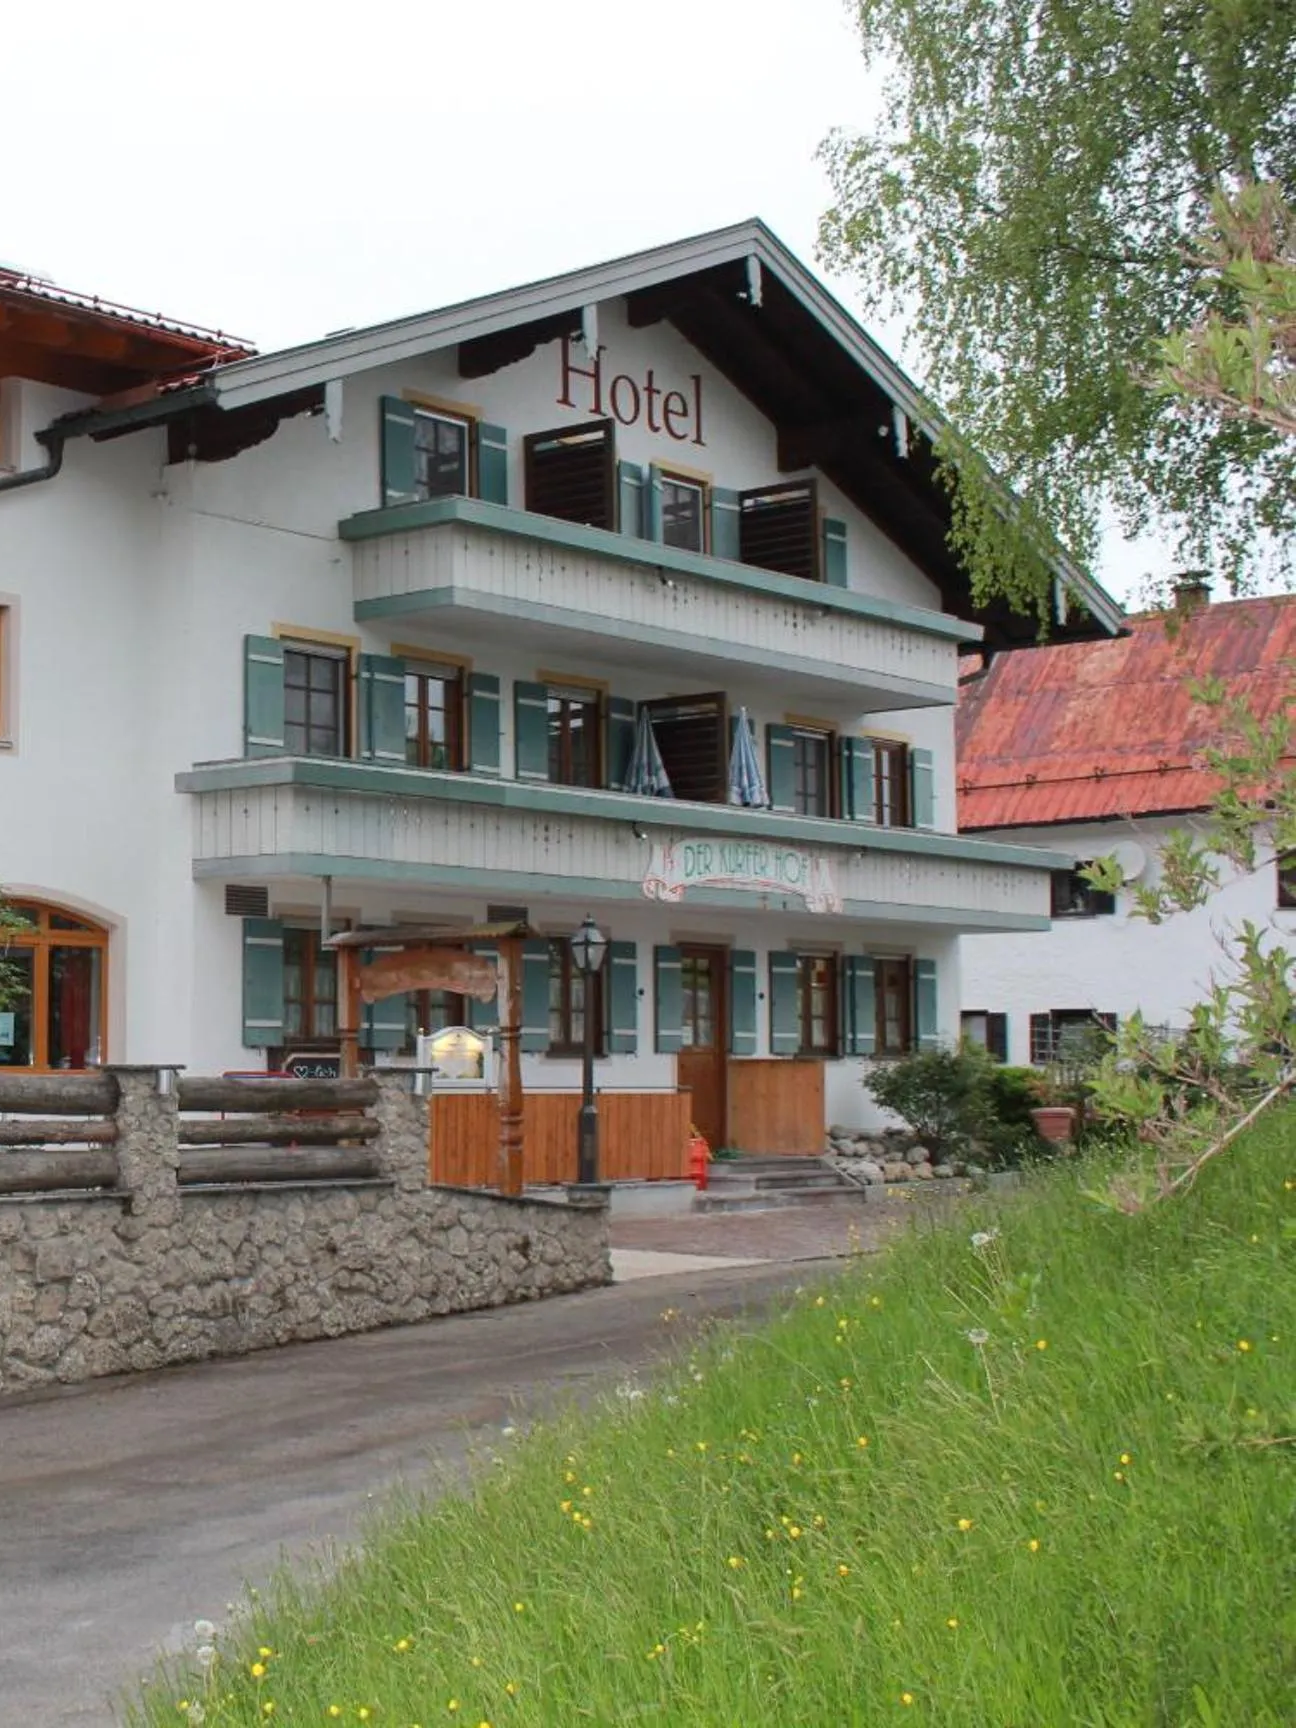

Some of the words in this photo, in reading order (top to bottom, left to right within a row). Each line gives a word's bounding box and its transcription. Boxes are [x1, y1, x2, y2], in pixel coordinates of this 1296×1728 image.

[556, 335, 706, 447] Hotel
[684, 843, 712, 878] DER
[774, 850, 809, 884] HOF
